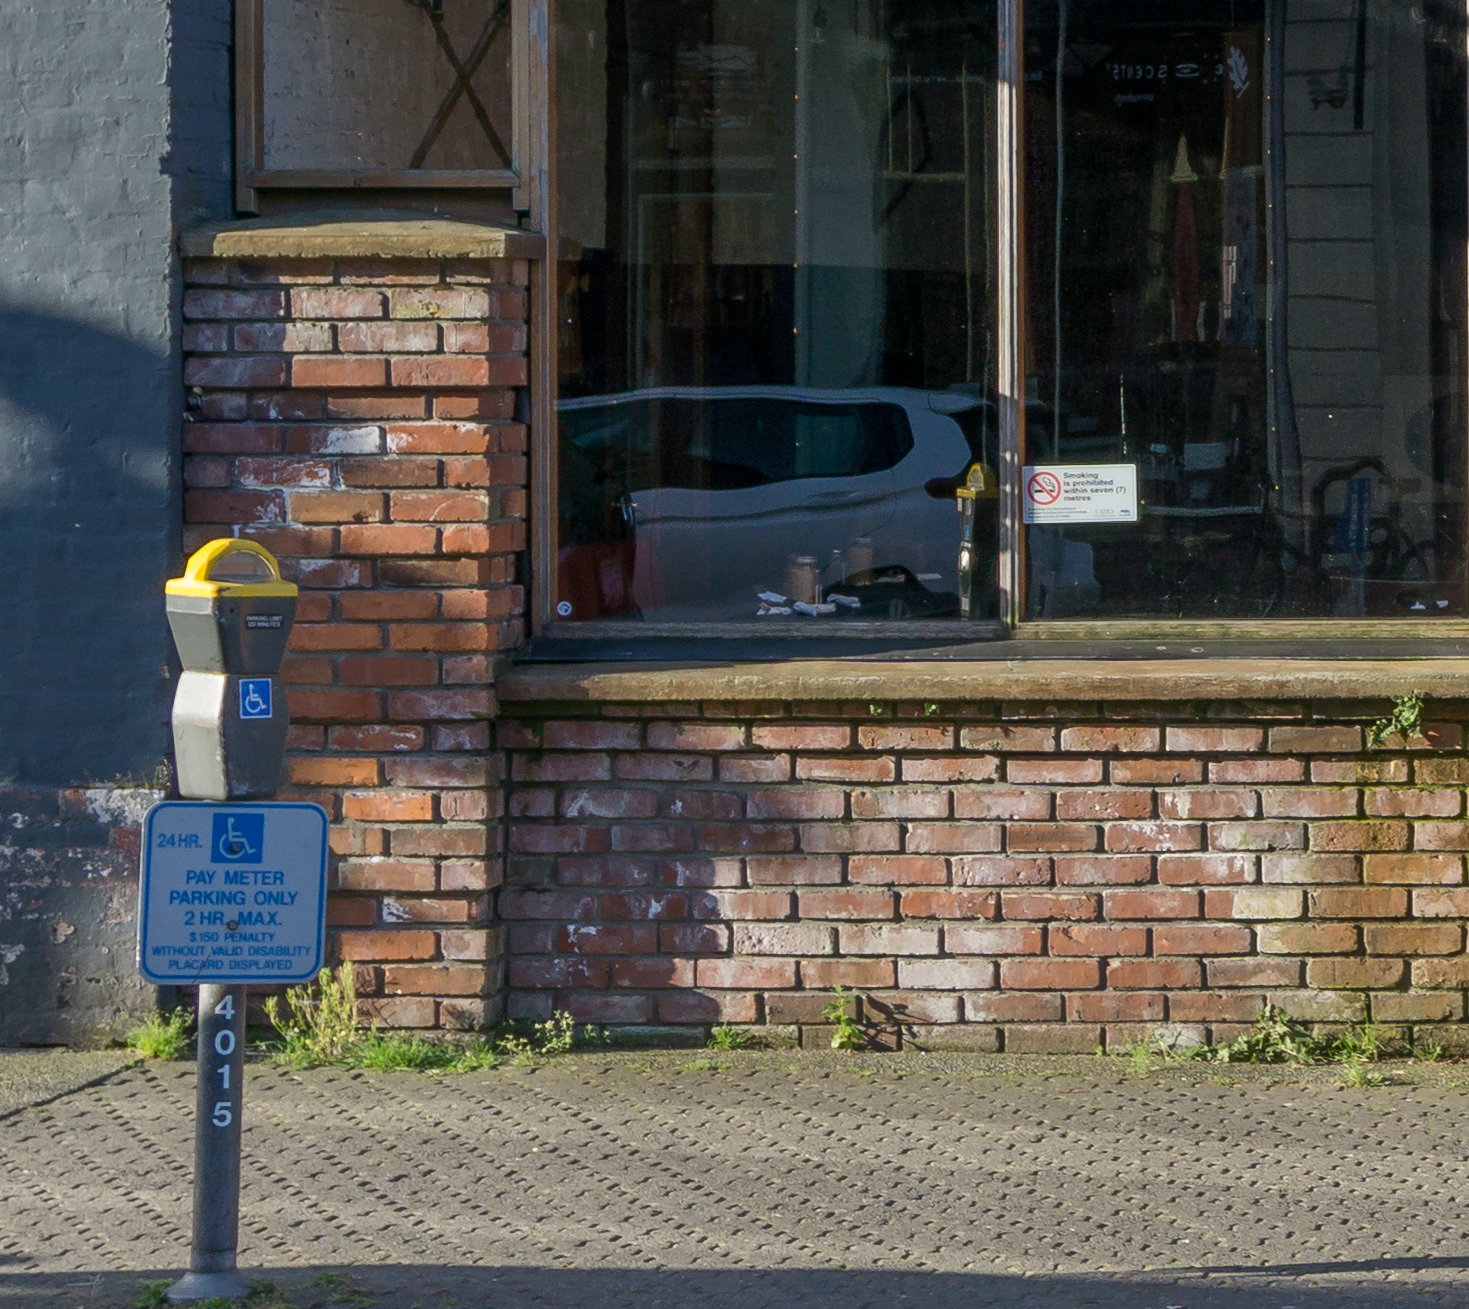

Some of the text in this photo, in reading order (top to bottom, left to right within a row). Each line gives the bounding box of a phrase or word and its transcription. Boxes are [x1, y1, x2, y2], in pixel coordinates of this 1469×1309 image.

[1072, 479, 1114, 487] prohibited
[1115, 486, 1127, 494] (7)
[185, 870, 285, 885] PAY METER
[169, 890, 298, 906] PARKING ONLY
[184, 911, 195, 926] 2
[237, 911, 283, 926] MAX.
[224, 932, 276, 942] PENALTY
[151, 946, 312, 956] WITHOUT VALID DISABILITY
[168, 960, 293, 970] PLACARD DISPLAYED
[212, 994, 236, 1127] 4015
